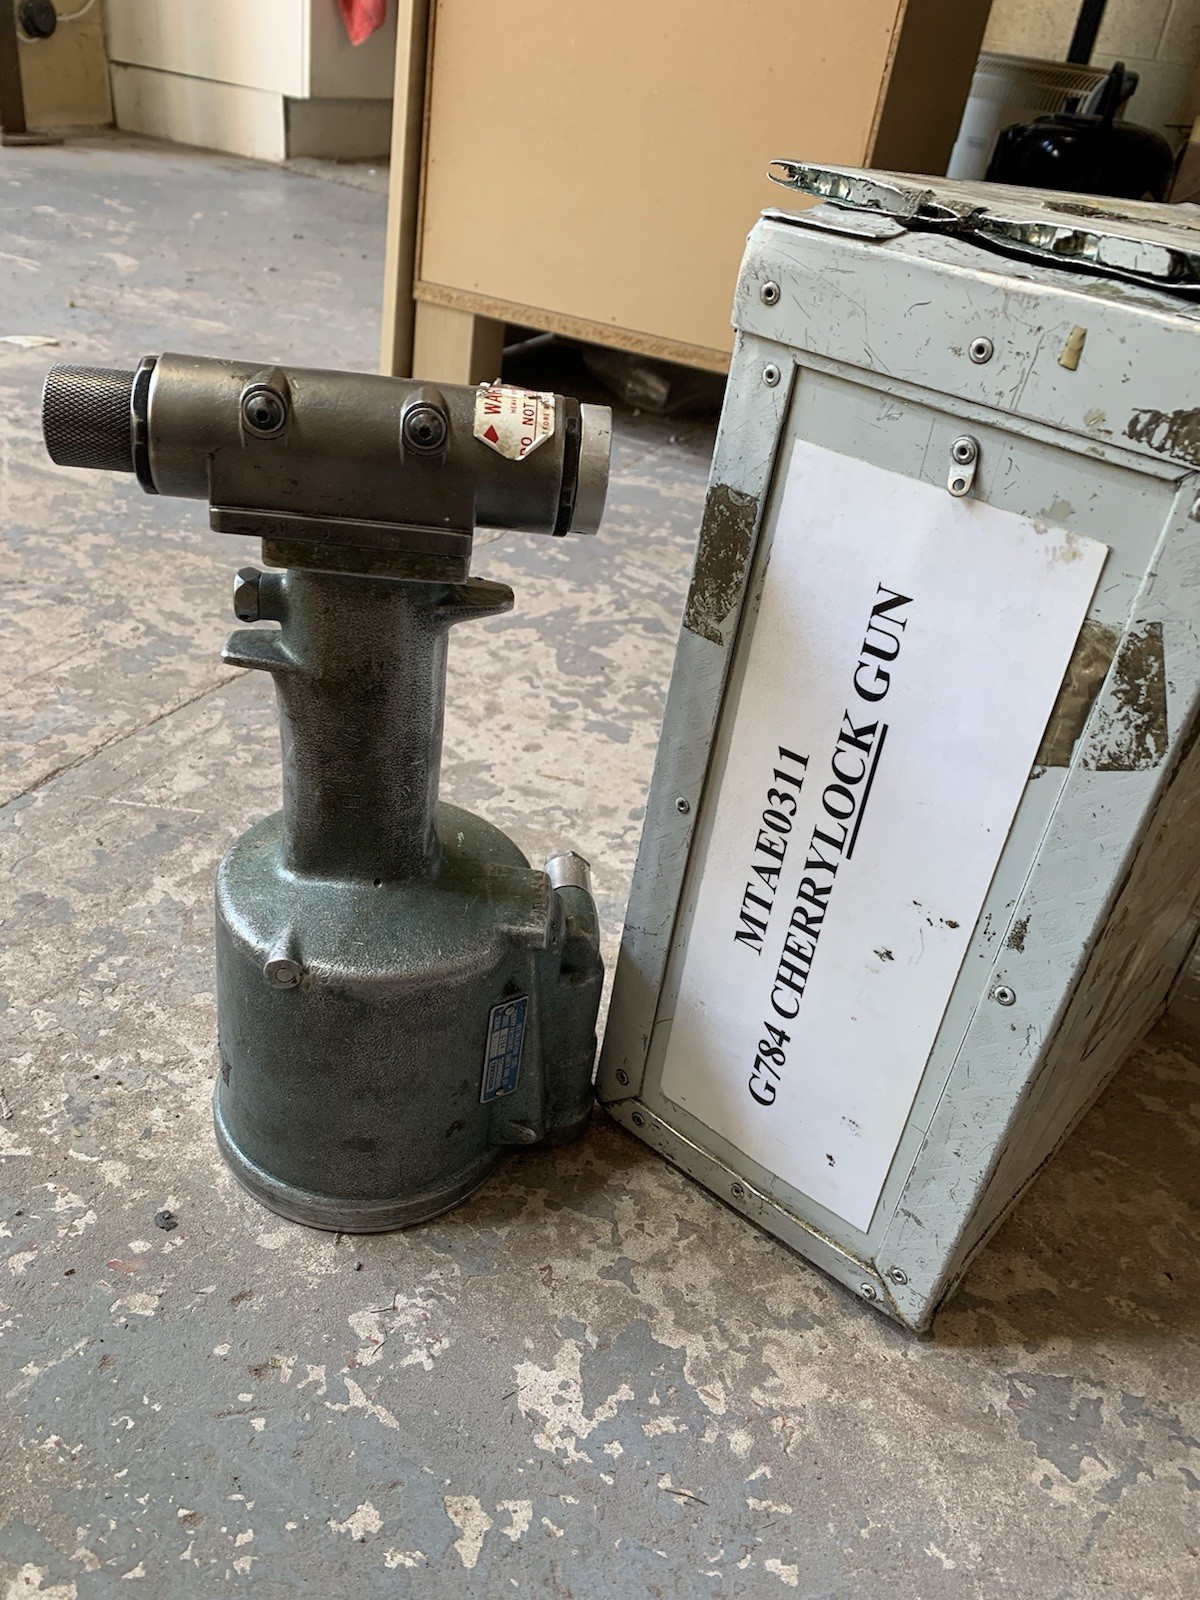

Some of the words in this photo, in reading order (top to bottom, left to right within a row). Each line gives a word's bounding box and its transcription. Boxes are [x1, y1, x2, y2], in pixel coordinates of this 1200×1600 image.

[522, 402, 535, 426] NOT
[734, 745, 809, 955] MTAE0311
[749, 1022, 791, 1105] G784
[771, 708, 883, 1019] CHERRYLOCK
[854, 582, 913, 701] GUN
